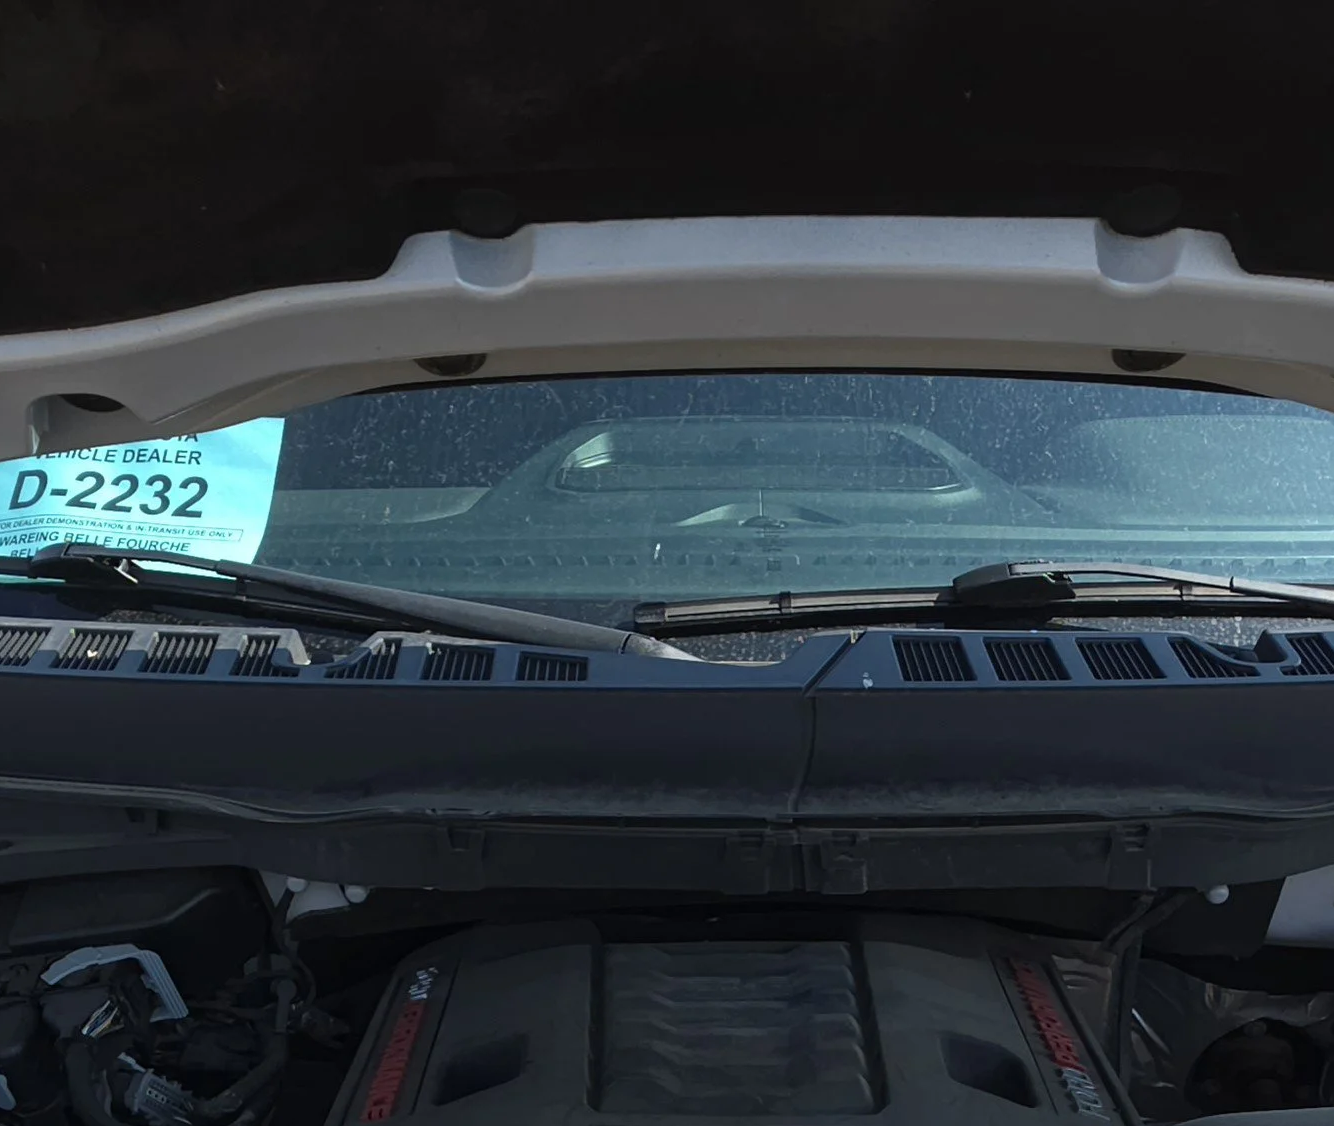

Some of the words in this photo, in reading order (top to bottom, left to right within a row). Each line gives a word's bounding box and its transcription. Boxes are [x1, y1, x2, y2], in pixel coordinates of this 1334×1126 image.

[122, 448, 202, 465] DEALER
[8, 469, 209, 519] D-2232
[12, 518, 46, 529] DEALER
[46, 517, 124, 530] DEMONSTRATION
[188, 529, 205, 537] USE
[208, 530, 233, 538] ONLY
[0, 531, 60, 547] WAREING
[63, 532, 114, 547] BELLE
[116, 537, 191, 552] FOURCHE
